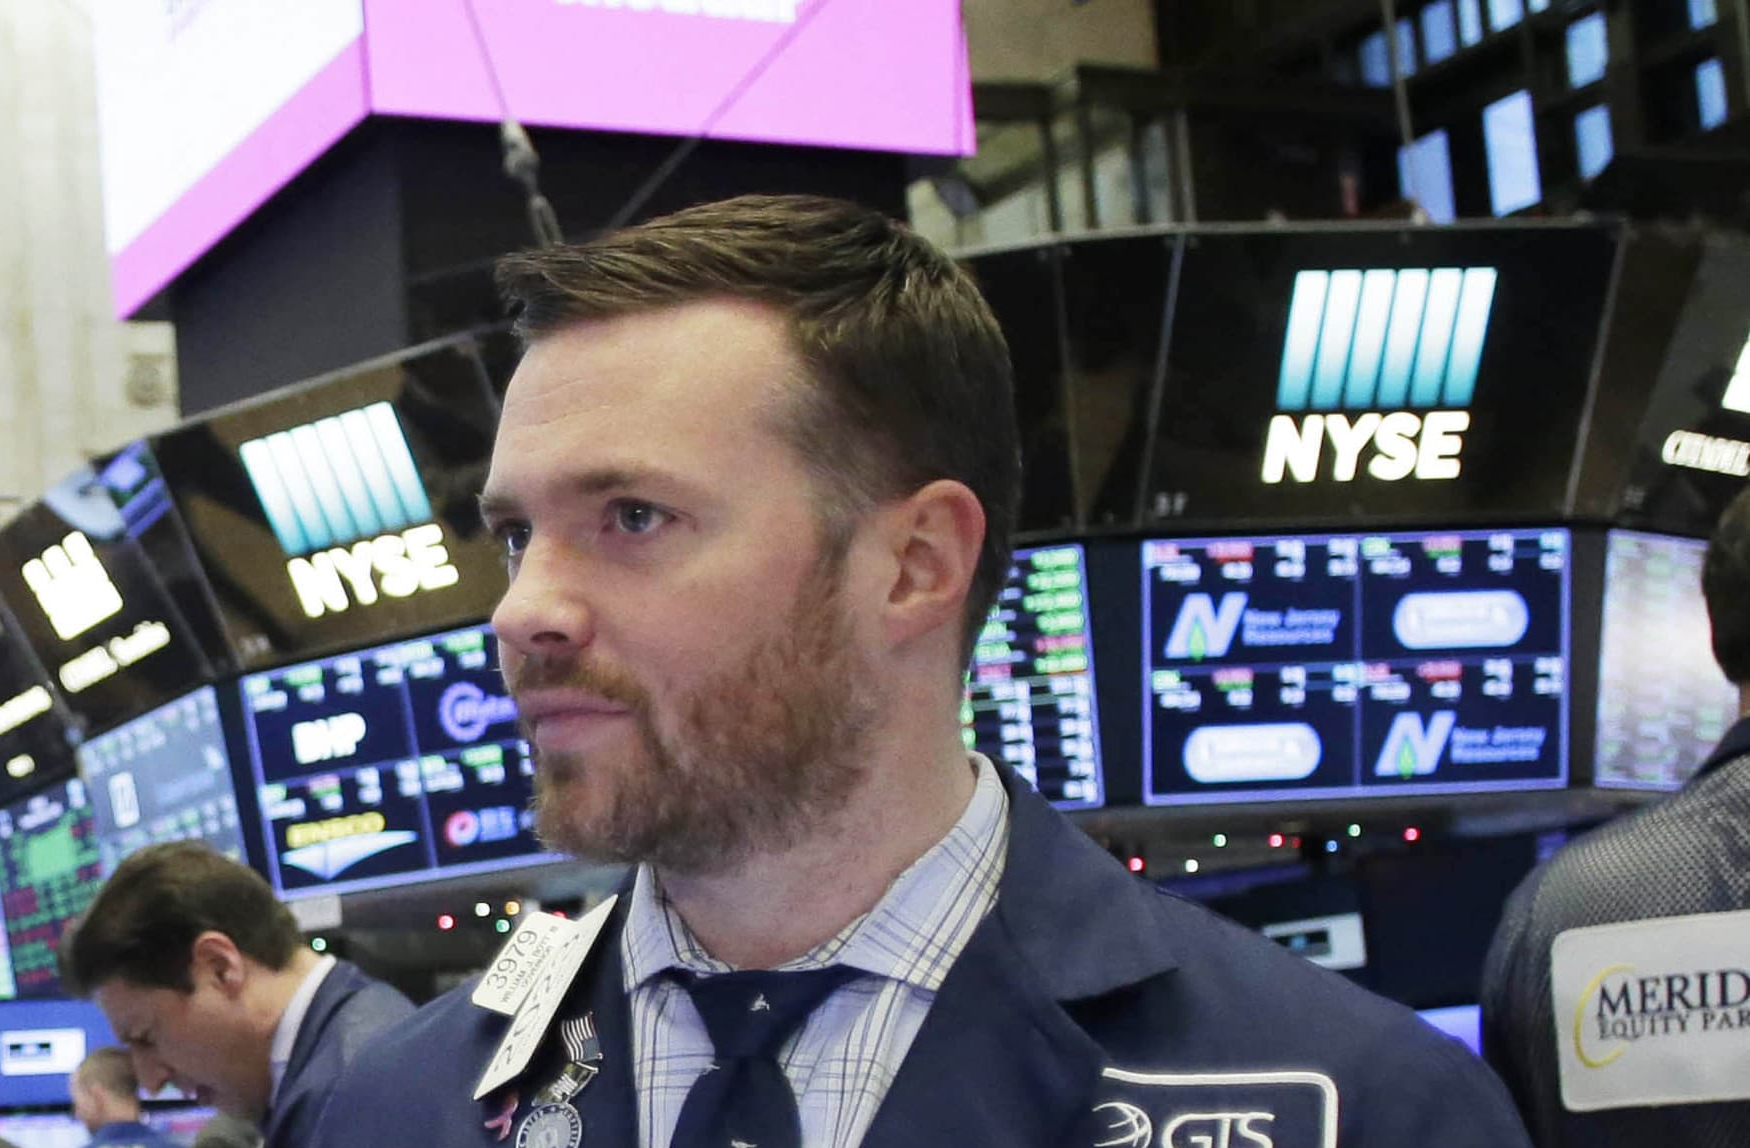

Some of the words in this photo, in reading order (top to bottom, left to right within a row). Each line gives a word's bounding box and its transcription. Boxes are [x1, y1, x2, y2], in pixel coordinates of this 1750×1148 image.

[1260, 410, 1471, 484] NYSE
[287, 523, 459, 619] NYSE
[486, 930, 538, 990] 3979
[1598, 970, 1750, 1017] MERID
[1599, 1012, 1690, 1041] EQUITY
[1703, 1008, 1750, 1031] PAR
